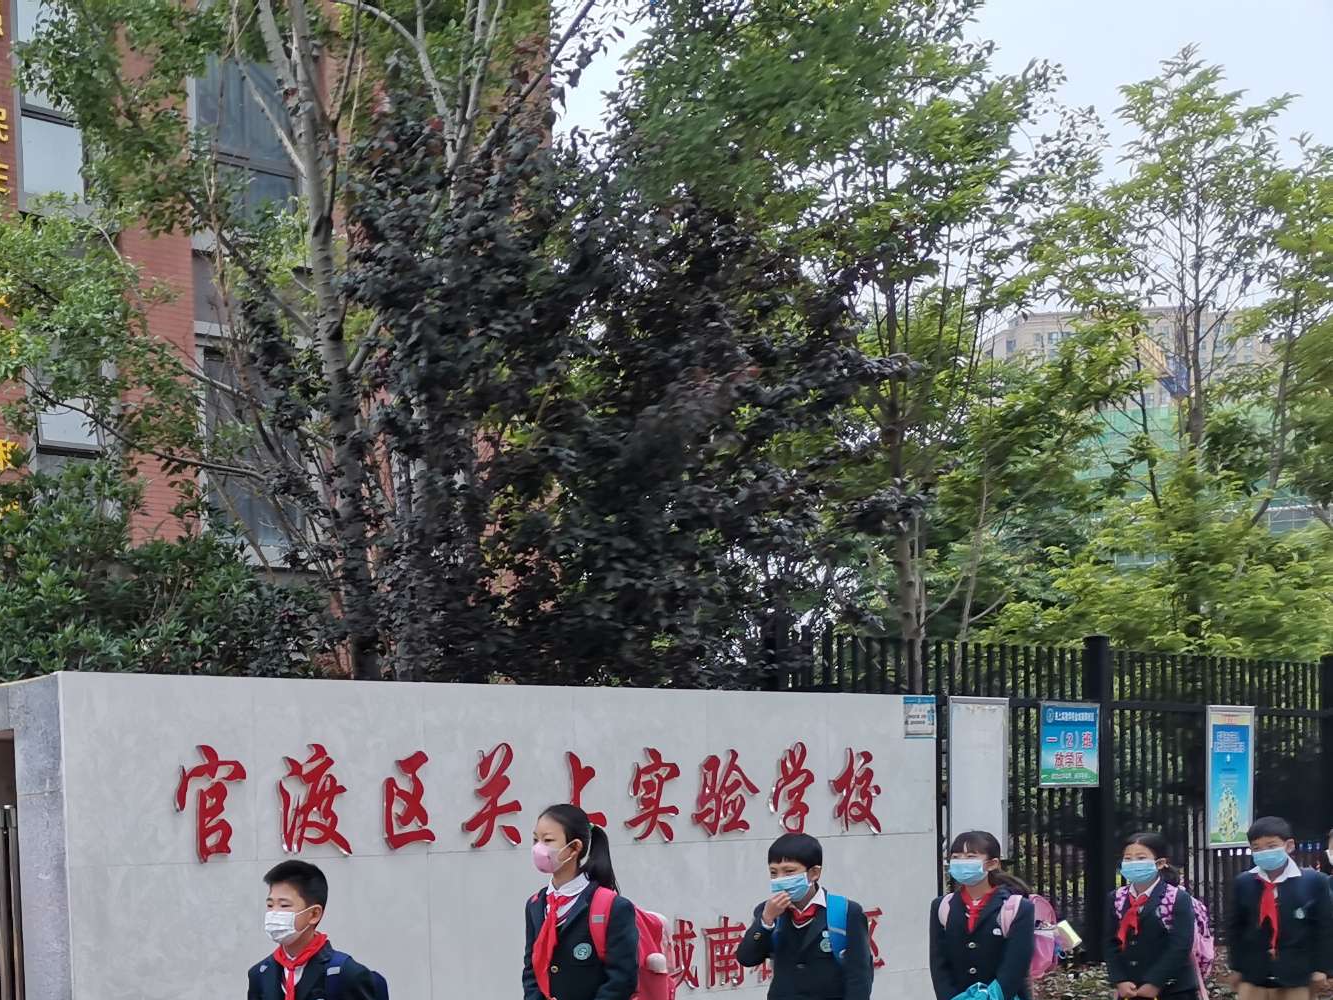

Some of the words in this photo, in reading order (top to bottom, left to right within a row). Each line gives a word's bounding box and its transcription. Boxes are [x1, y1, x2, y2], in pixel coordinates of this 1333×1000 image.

[174, 741, 883, 864] 官渡区关上实验学校
